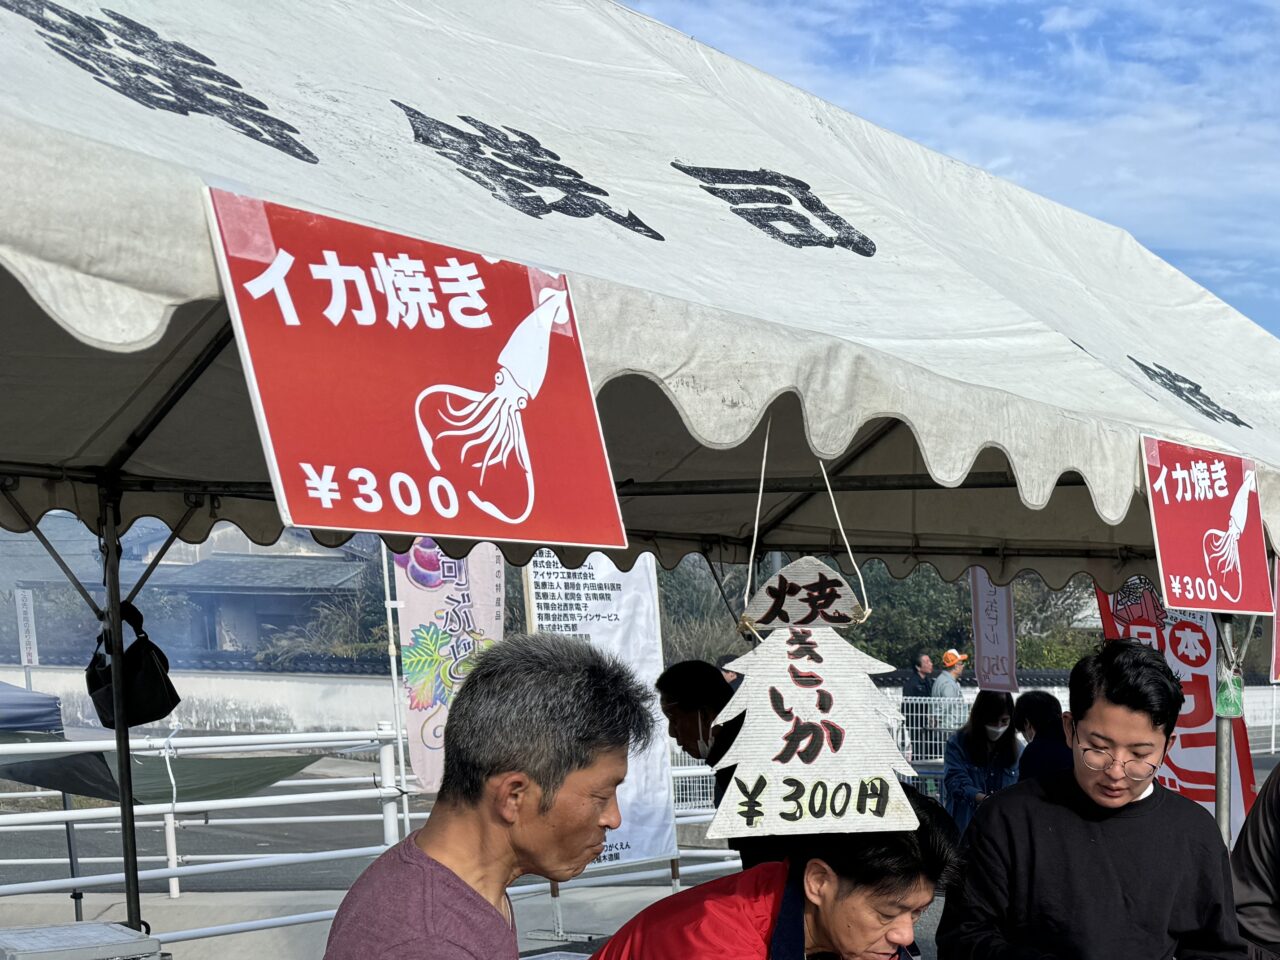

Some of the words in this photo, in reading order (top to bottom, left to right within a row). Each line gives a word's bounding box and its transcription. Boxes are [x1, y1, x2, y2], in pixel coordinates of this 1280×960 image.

[244, 247, 492, 330] イカ焼き
[299, 460, 460, 520] ¥300
[1152, 459, 1230, 505] イカ焼き
[1171, 573, 1218, 601] ¥300
[756, 572, 856, 765] 焼きいか
[735, 775, 890, 827] ¥300円
